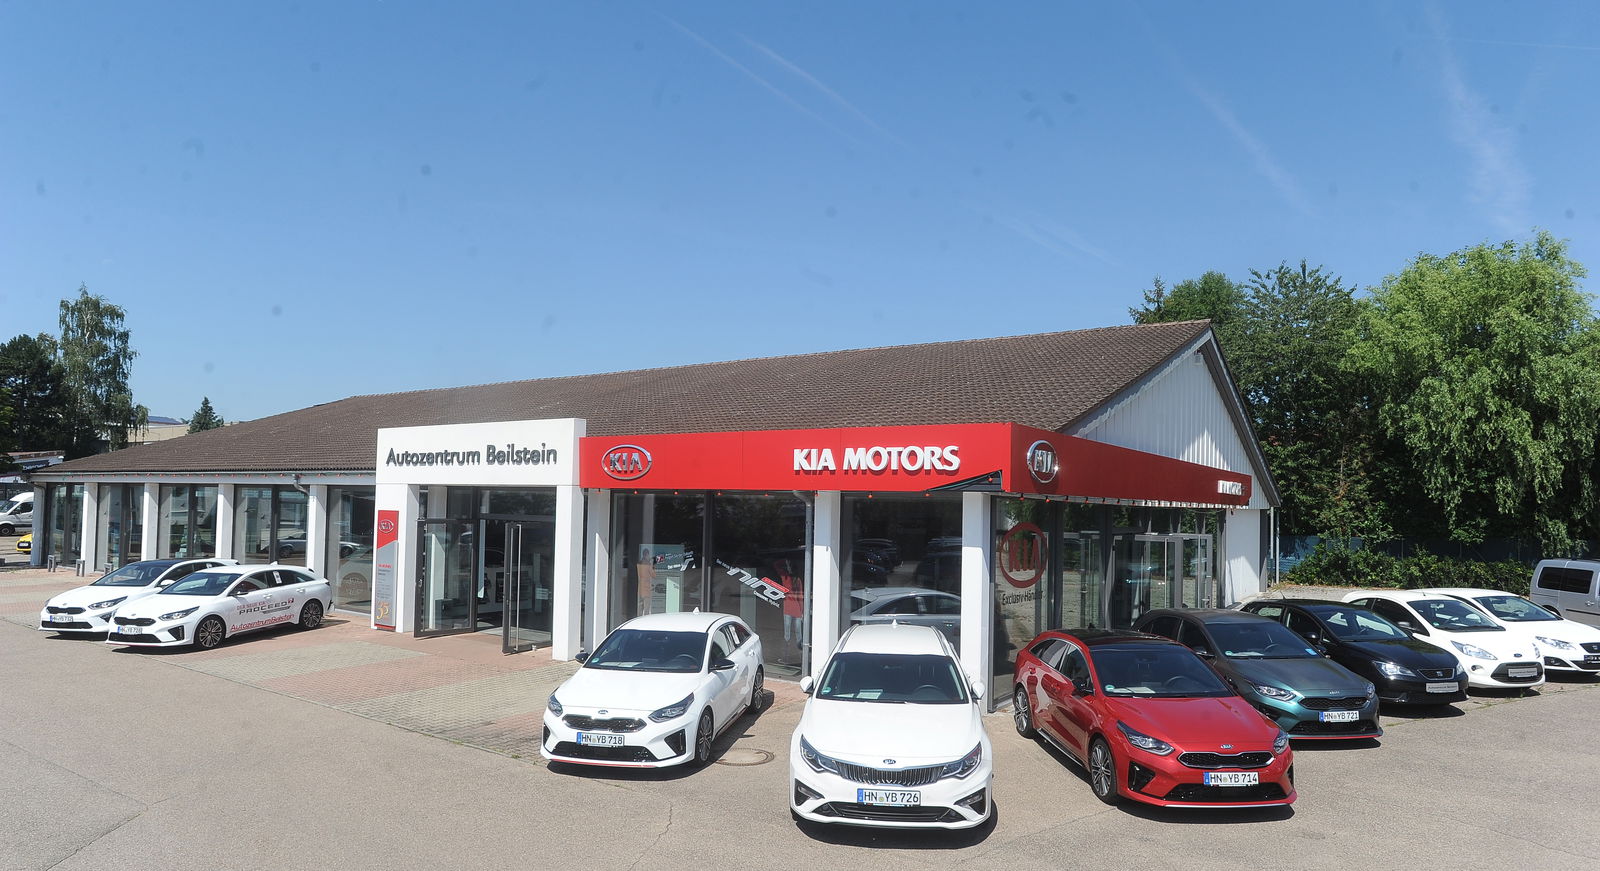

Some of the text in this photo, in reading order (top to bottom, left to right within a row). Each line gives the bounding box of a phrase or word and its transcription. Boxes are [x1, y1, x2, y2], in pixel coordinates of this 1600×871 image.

[386, 443, 557, 467] Autozentrum Beilstein
[609, 452, 643, 473] KIA
[793, 445, 961, 474] KIA MOTORS
[1008, 538, 1041, 572] KIA
[727, 567, 786, 601] niro
[239, 601, 288, 615] PROCEED
[581, 735, 623, 745] HN YB 718
[1210, 774, 1258, 783] HN YB 714
[864, 791, 919, 803] HN YB 726
